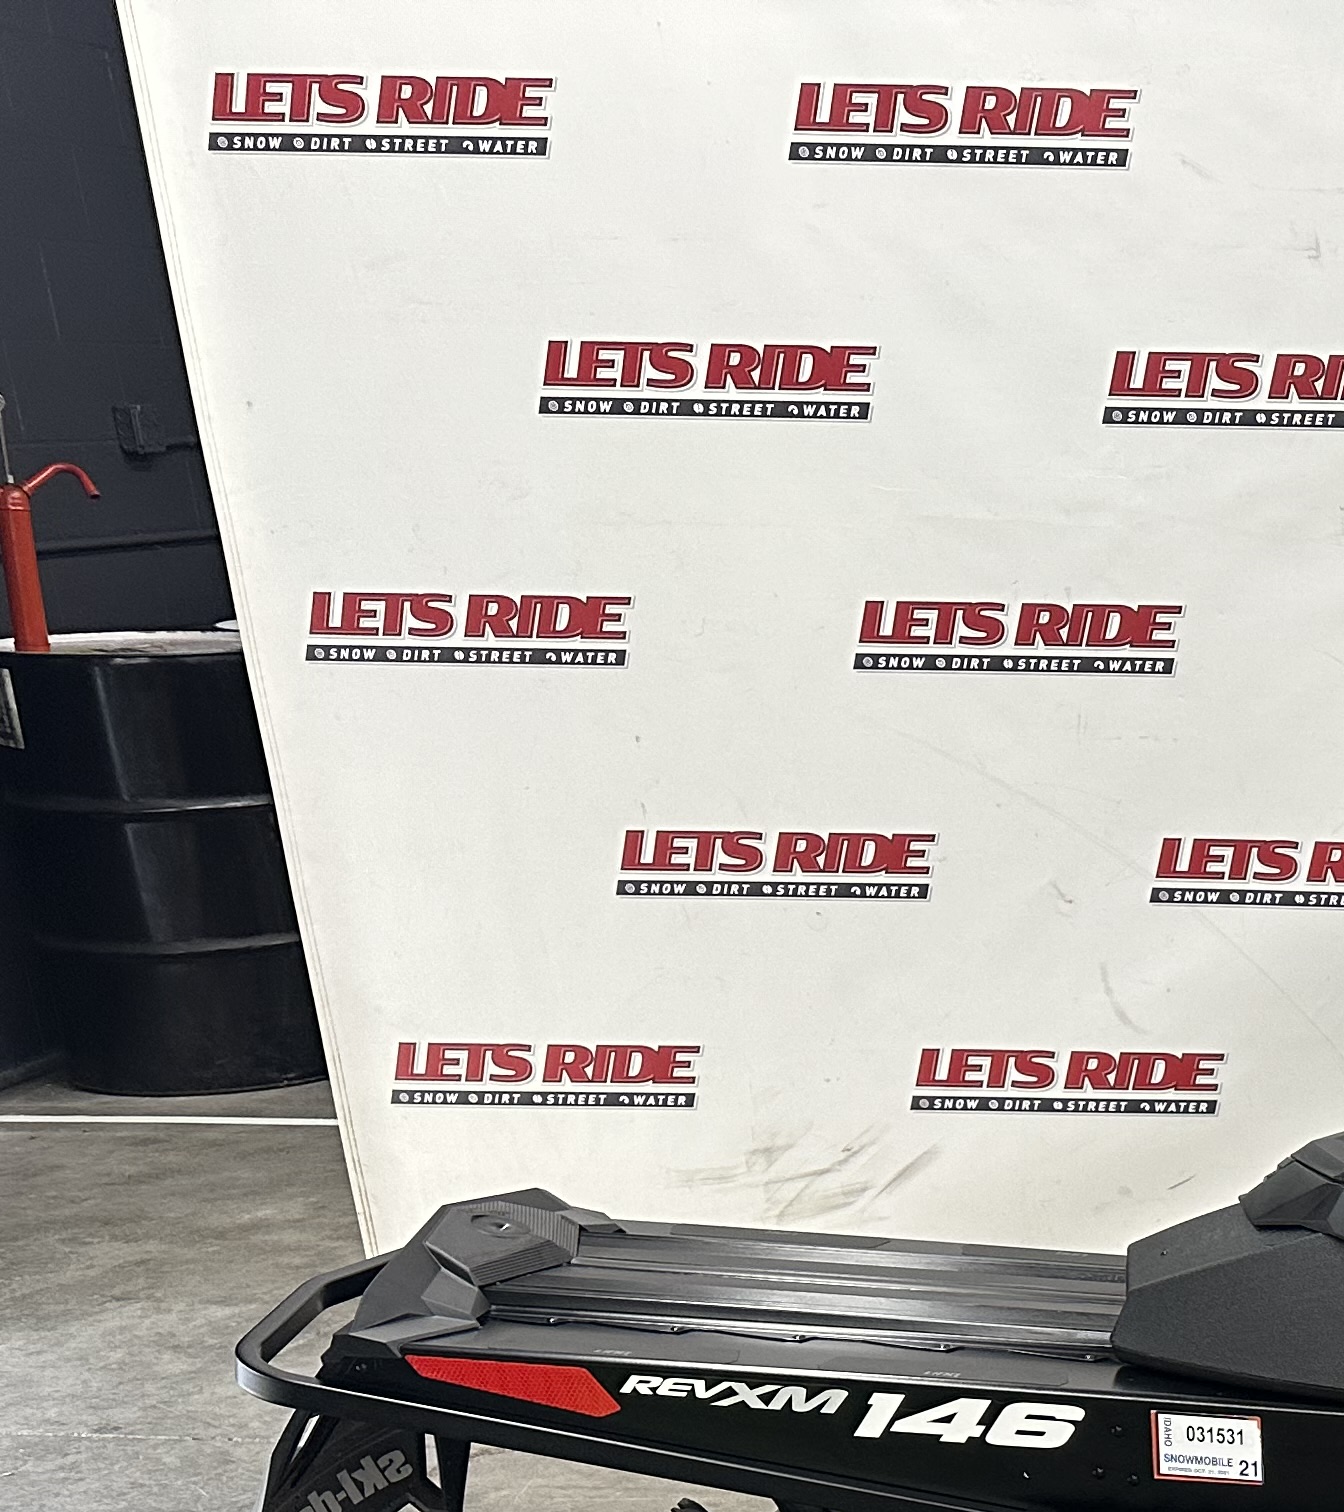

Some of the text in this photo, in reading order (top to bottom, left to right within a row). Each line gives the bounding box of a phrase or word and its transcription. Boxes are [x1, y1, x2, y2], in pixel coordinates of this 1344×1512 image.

[212, 73, 553, 126] LETS RIDE
[794, 83, 1137, 137] LETS RIDE
[232, 135, 538, 153] SNOW DIRT STREET WATER
[813, 145, 1119, 165] SNOW DIRT STREET WATER
[543, 341, 876, 392] LETS RIDE
[1109, 351, 1260, 399] LETS
[563, 399, 860, 417] SNOW DIRT STREET WATER
[1126, 410, 1177, 423] SNOW
[1201, 411, 1244, 424] DIRT
[1269, 412, 1336, 426] STREET
[310, 592, 631, 639] LETS RIDE
[859, 601, 1182, 648] LETS RIDE
[328, 647, 617, 664] SNOW DIRT STREET WATER
[877, 656, 1165, 672] SNOW DIRT STREET WATER
[621, 830, 935, 874] LETS RIDE
[1156, 838, 1298, 881] LETS
[639, 882, 920, 897] SNOW DIRT STREET WATER
[1172, 890, 1221, 903] SNOW
[1244, 892, 1284, 904] DIRT
[395, 1043, 700, 1084] LETS RIDE
[916, 1049, 1224, 1091] LETS RIDE
[412, 1092, 687, 1105] SNOW DIRT STREET WATER
[853, 1392, 1086, 1448] 146
[1163, 1417, 1173, 1447] IDAHO
[1186, 1425, 1244, 1446] 031531
[1163, 1453, 1234, 1468] SNOWMOBILE
[1238, 1459, 1258, 1478] 21
